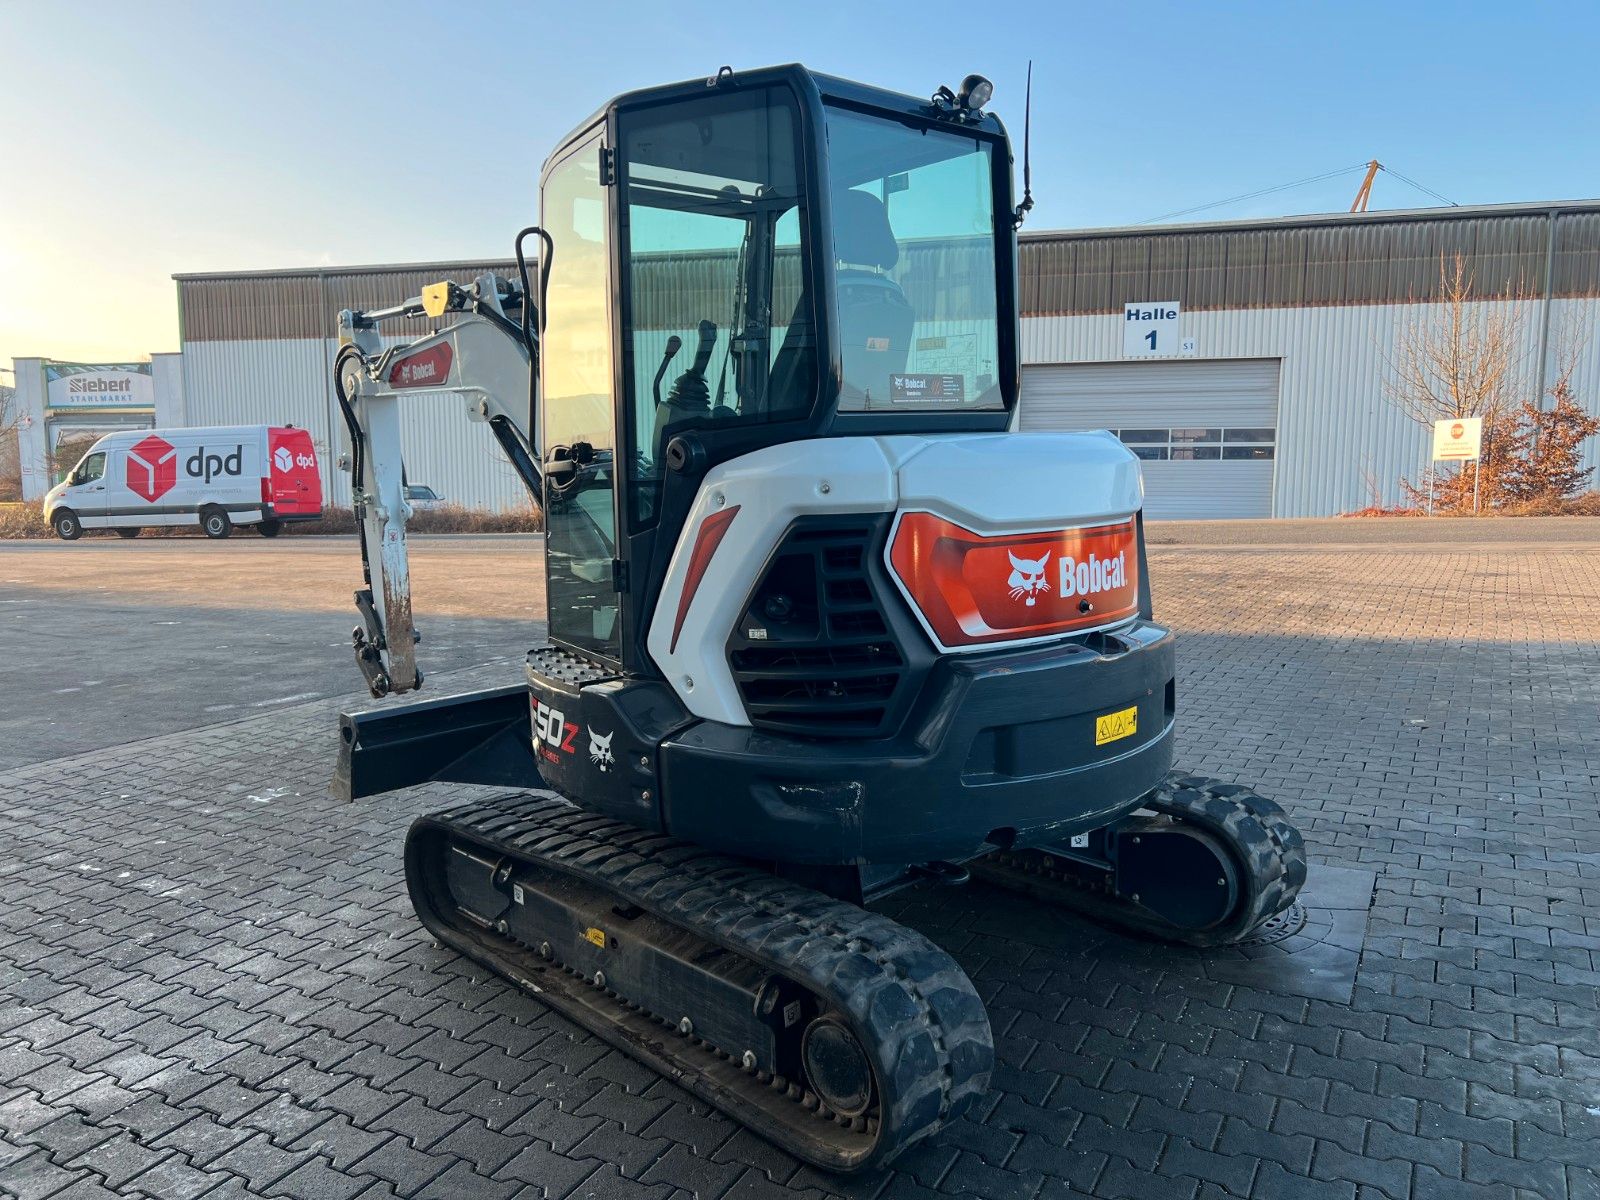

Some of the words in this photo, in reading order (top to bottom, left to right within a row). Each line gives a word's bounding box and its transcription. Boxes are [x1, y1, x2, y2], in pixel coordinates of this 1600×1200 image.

[1126, 308, 1177, 321] Halle
[1145, 330, 1157, 350] 1
[412, 360, 435, 380] Bobcat
[69, 377, 131, 393] Siebert
[904, 378, 926, 389] Bobcat
[186, 444, 242, 484] dpd
[296, 452, 314, 470] dpd
[1059, 550, 1126, 598] Bobcat
